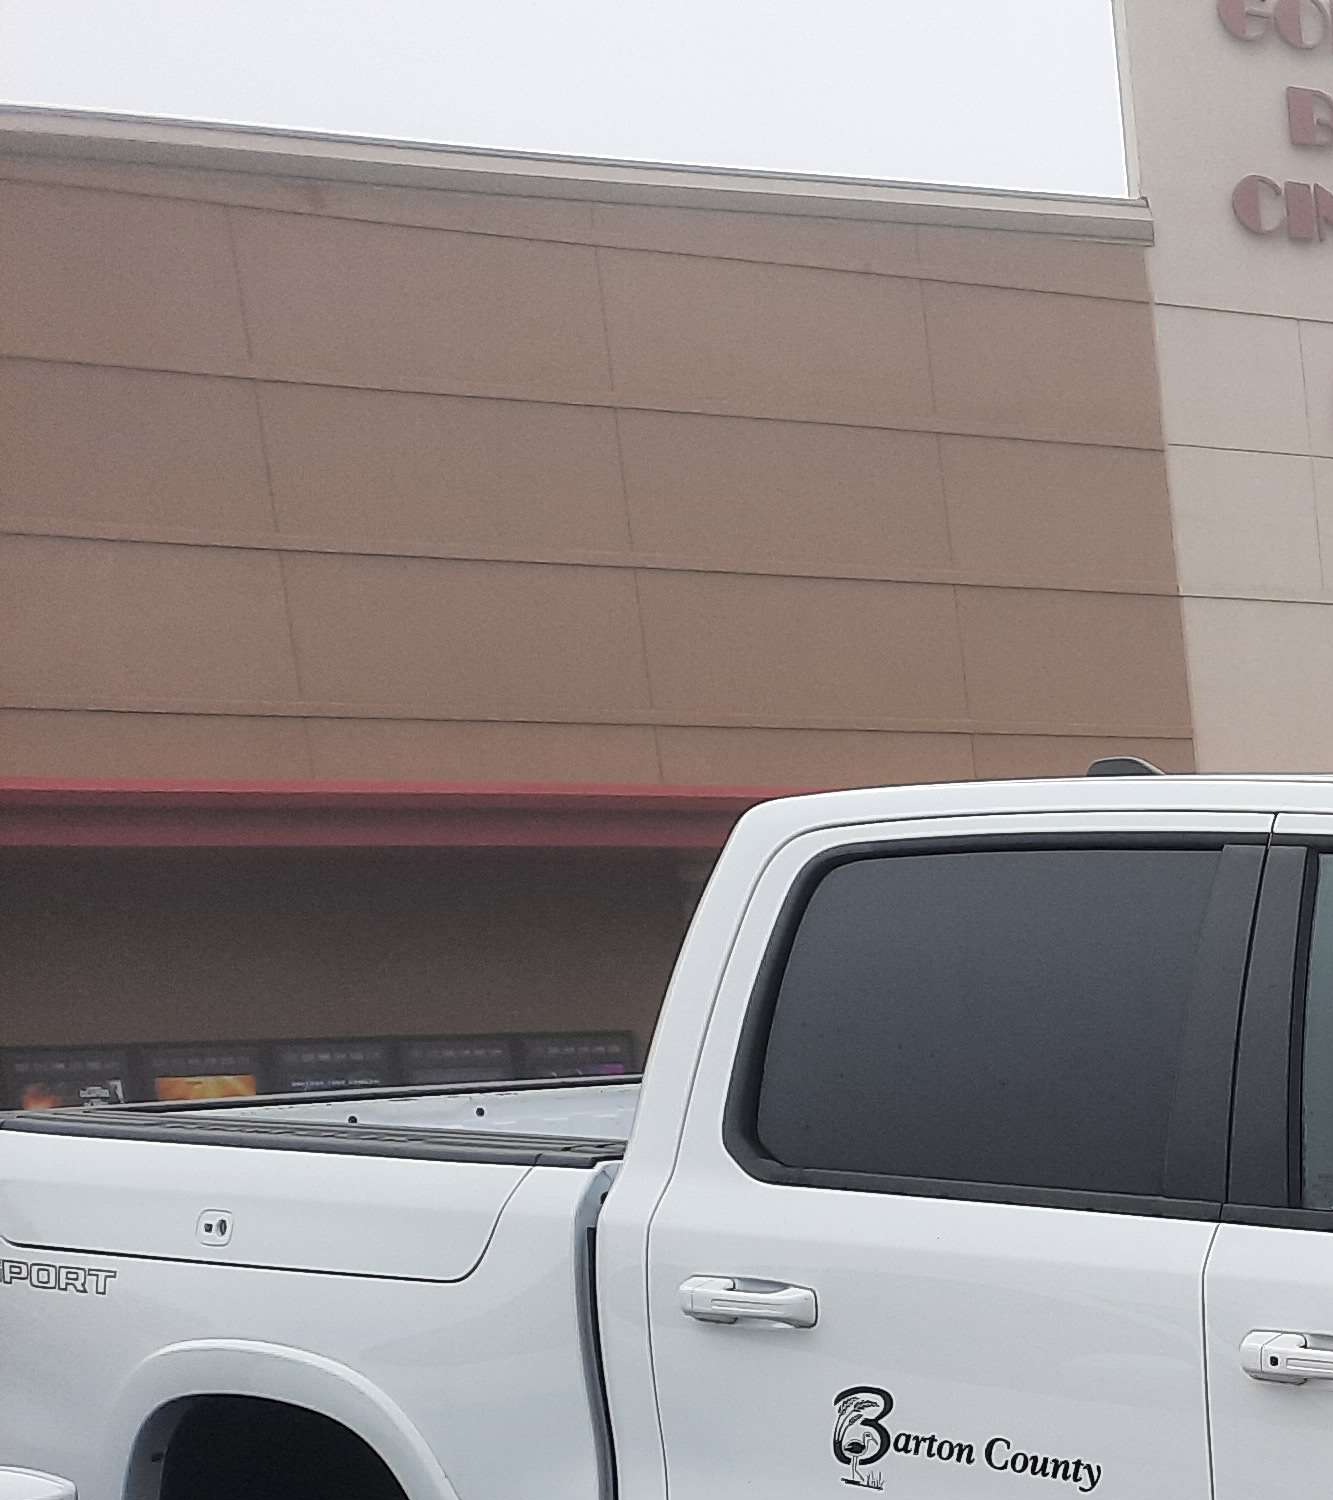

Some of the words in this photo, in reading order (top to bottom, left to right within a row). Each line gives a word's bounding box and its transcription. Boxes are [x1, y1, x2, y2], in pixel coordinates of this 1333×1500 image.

[0, 1258, 117, 1296] PORT
[832, 1385, 976, 1467] Barton
[984, 1436, 1102, 1493] County
